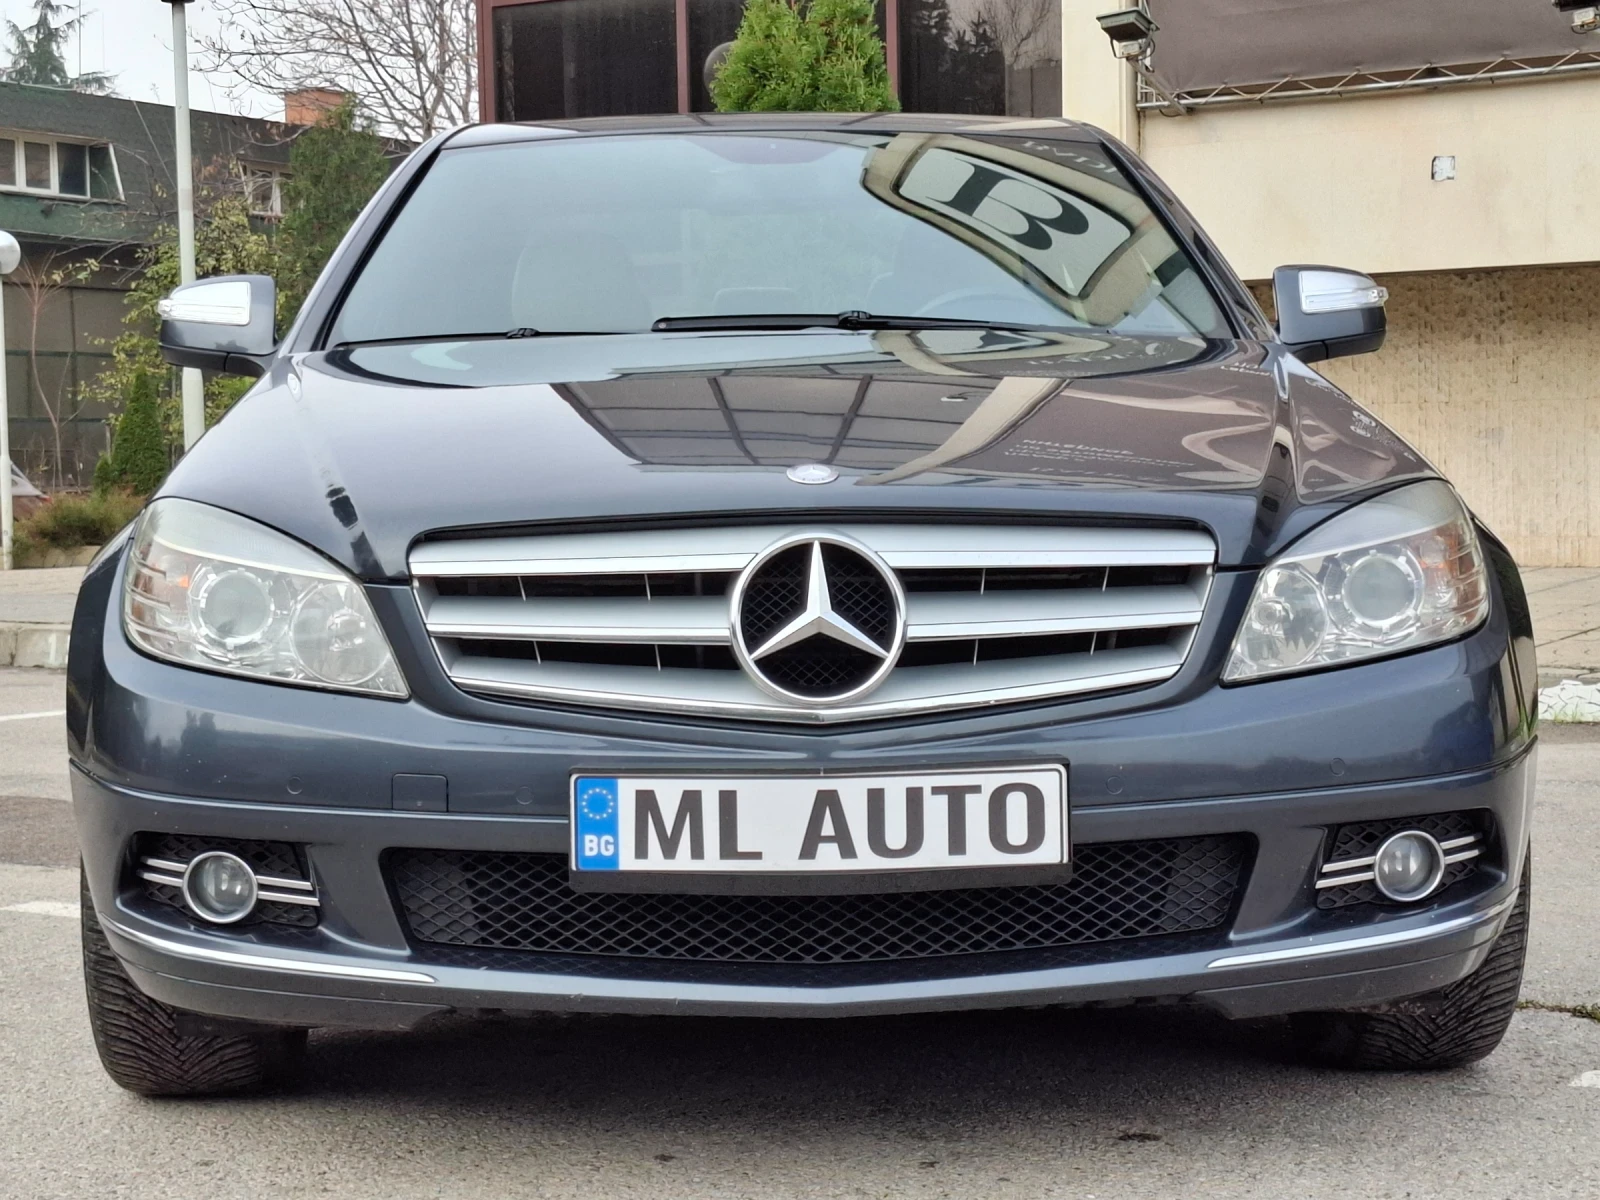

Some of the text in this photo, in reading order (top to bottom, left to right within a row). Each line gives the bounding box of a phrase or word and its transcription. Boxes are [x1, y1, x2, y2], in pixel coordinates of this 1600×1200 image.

[584, 834, 615, 857] BG
[634, 782, 1046, 860] ML AUTO
